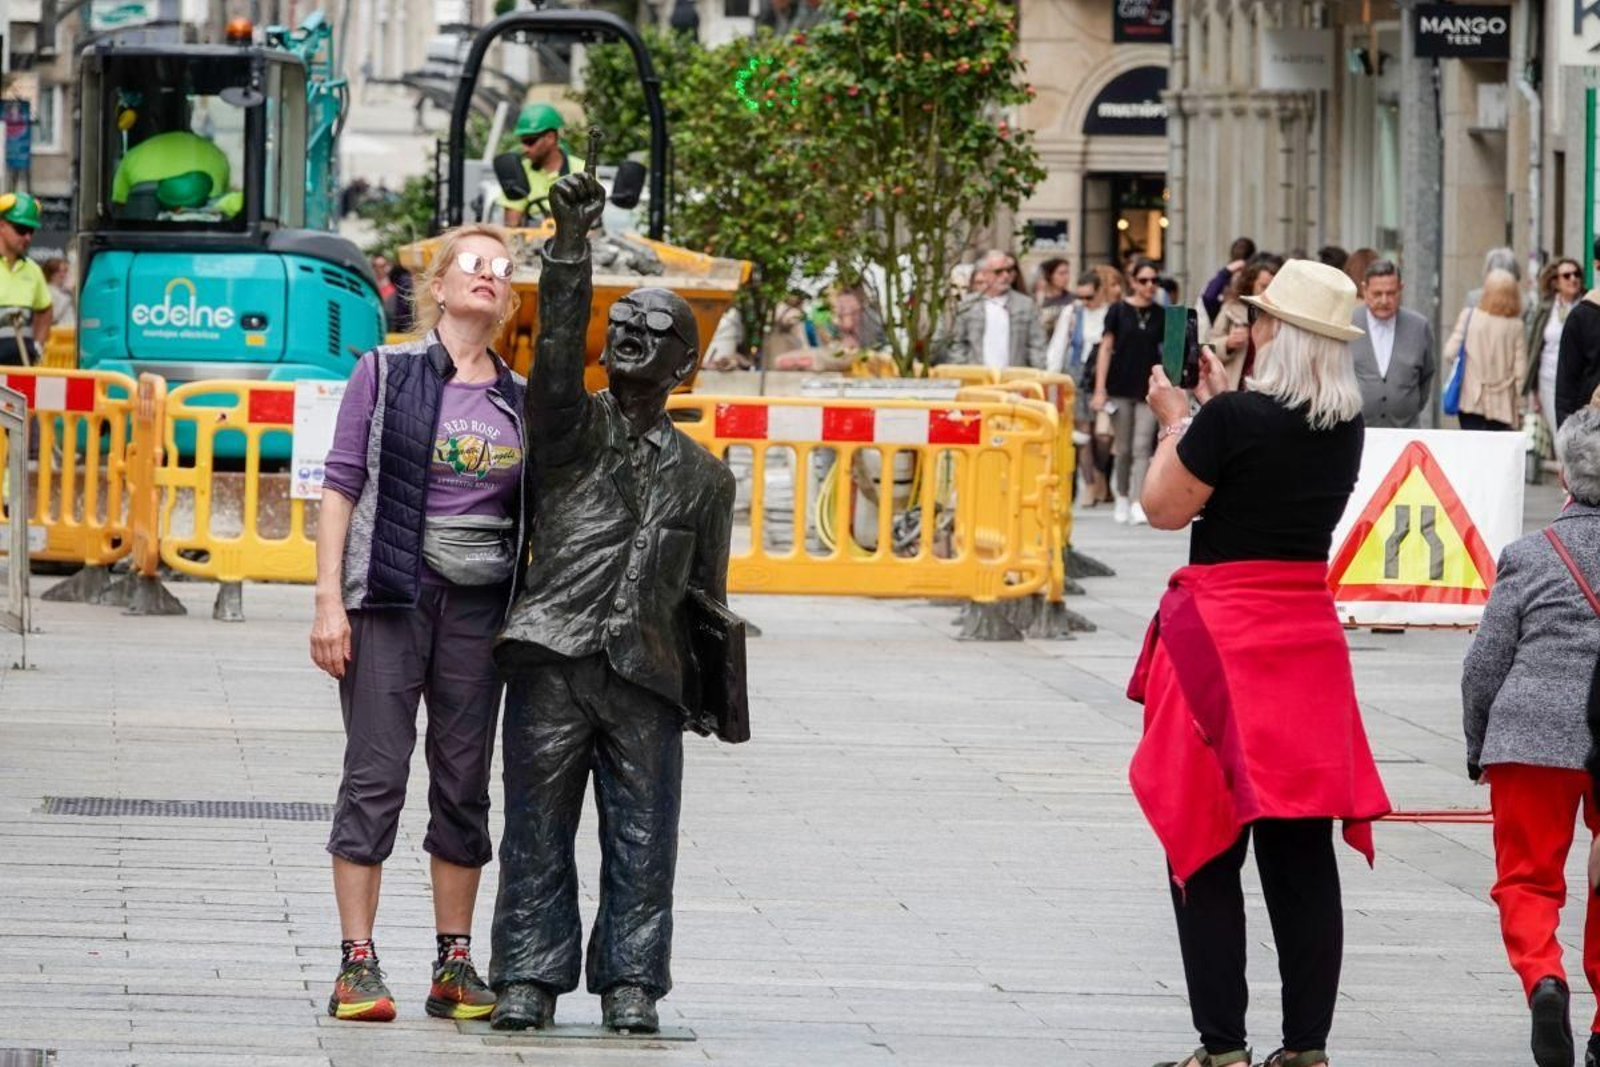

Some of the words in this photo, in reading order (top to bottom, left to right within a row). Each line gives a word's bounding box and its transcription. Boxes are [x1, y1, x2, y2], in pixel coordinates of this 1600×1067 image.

[1420, 16, 1507, 34] MANGO
[1446, 34, 1482, 45] TEEN
[443, 419, 468, 434] RED
[471, 420, 501, 440] ROSE
